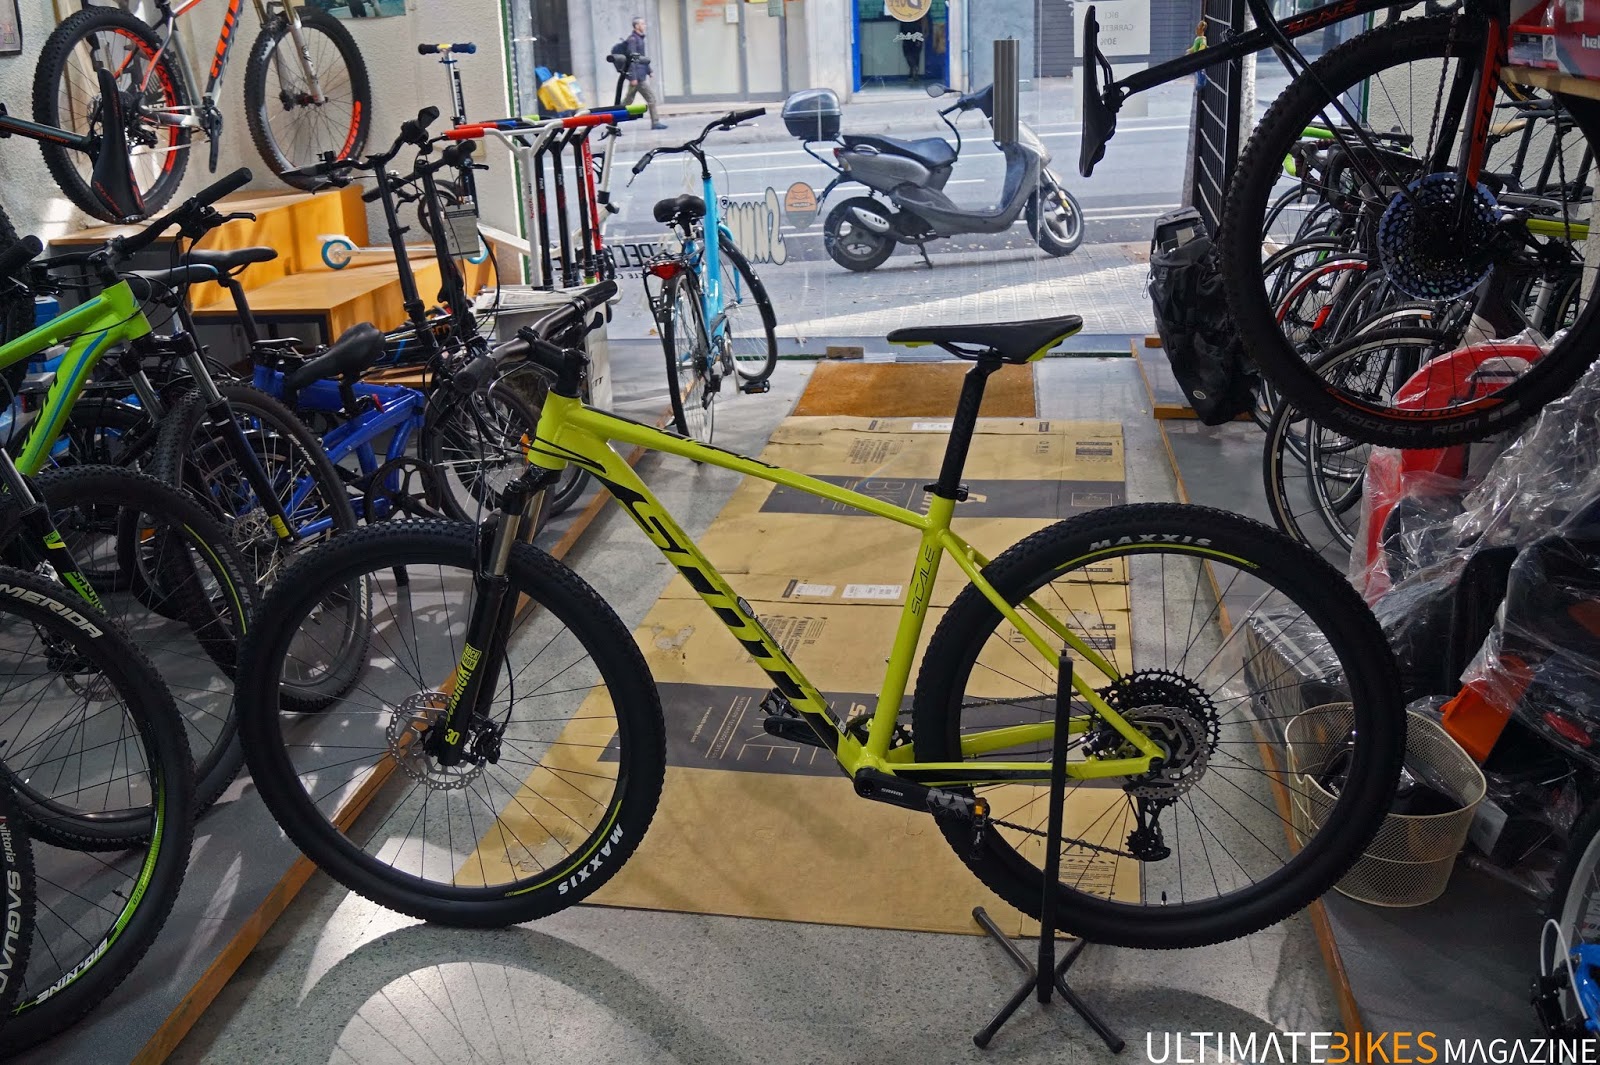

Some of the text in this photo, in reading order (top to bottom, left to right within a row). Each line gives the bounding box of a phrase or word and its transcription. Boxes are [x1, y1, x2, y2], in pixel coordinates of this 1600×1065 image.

[1089, 534, 1213, 552] MAXXIS
[911, 545, 937, 618] SCALE
[0, 584, 104, 639] MERIDA
[444, 727, 460, 746] 30
[557, 822, 624, 895] MAXXIS
